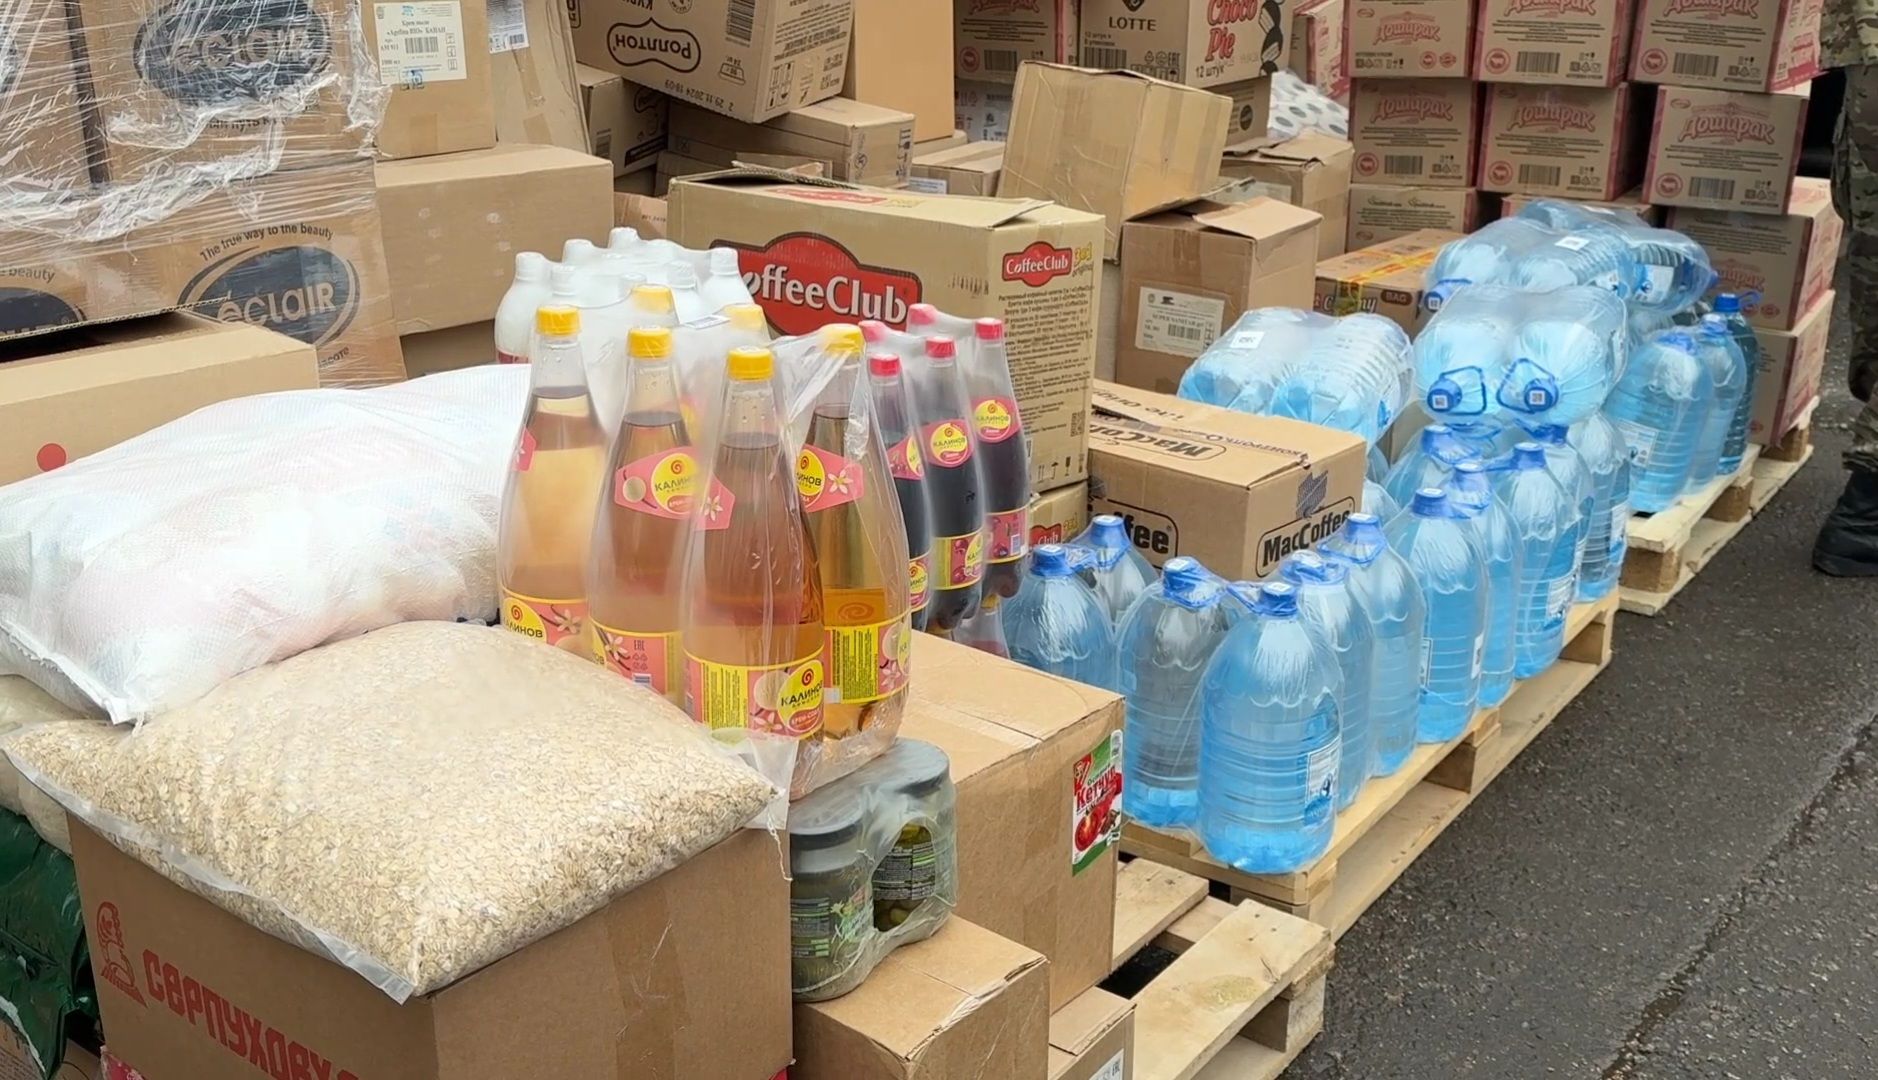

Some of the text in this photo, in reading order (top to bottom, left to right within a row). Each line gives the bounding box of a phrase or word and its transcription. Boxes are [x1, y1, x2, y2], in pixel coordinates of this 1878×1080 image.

[1109, 16, 1157, 31] LOTTE
[1207, 0, 1258, 25] Choco
[1205, 26, 1237, 62] Pie
[1507, 106, 1596, 133] Доширак
[1678, 115, 1776, 145] Доширак
[200, 222, 334, 261] The true way to the beauty
[9, 267, 56, 284] beauty
[1006, 254, 1068, 274] CoffeeClub
[742, 264, 907, 324] offeeClub
[1262, 509, 1351, 567] MacCoffee
